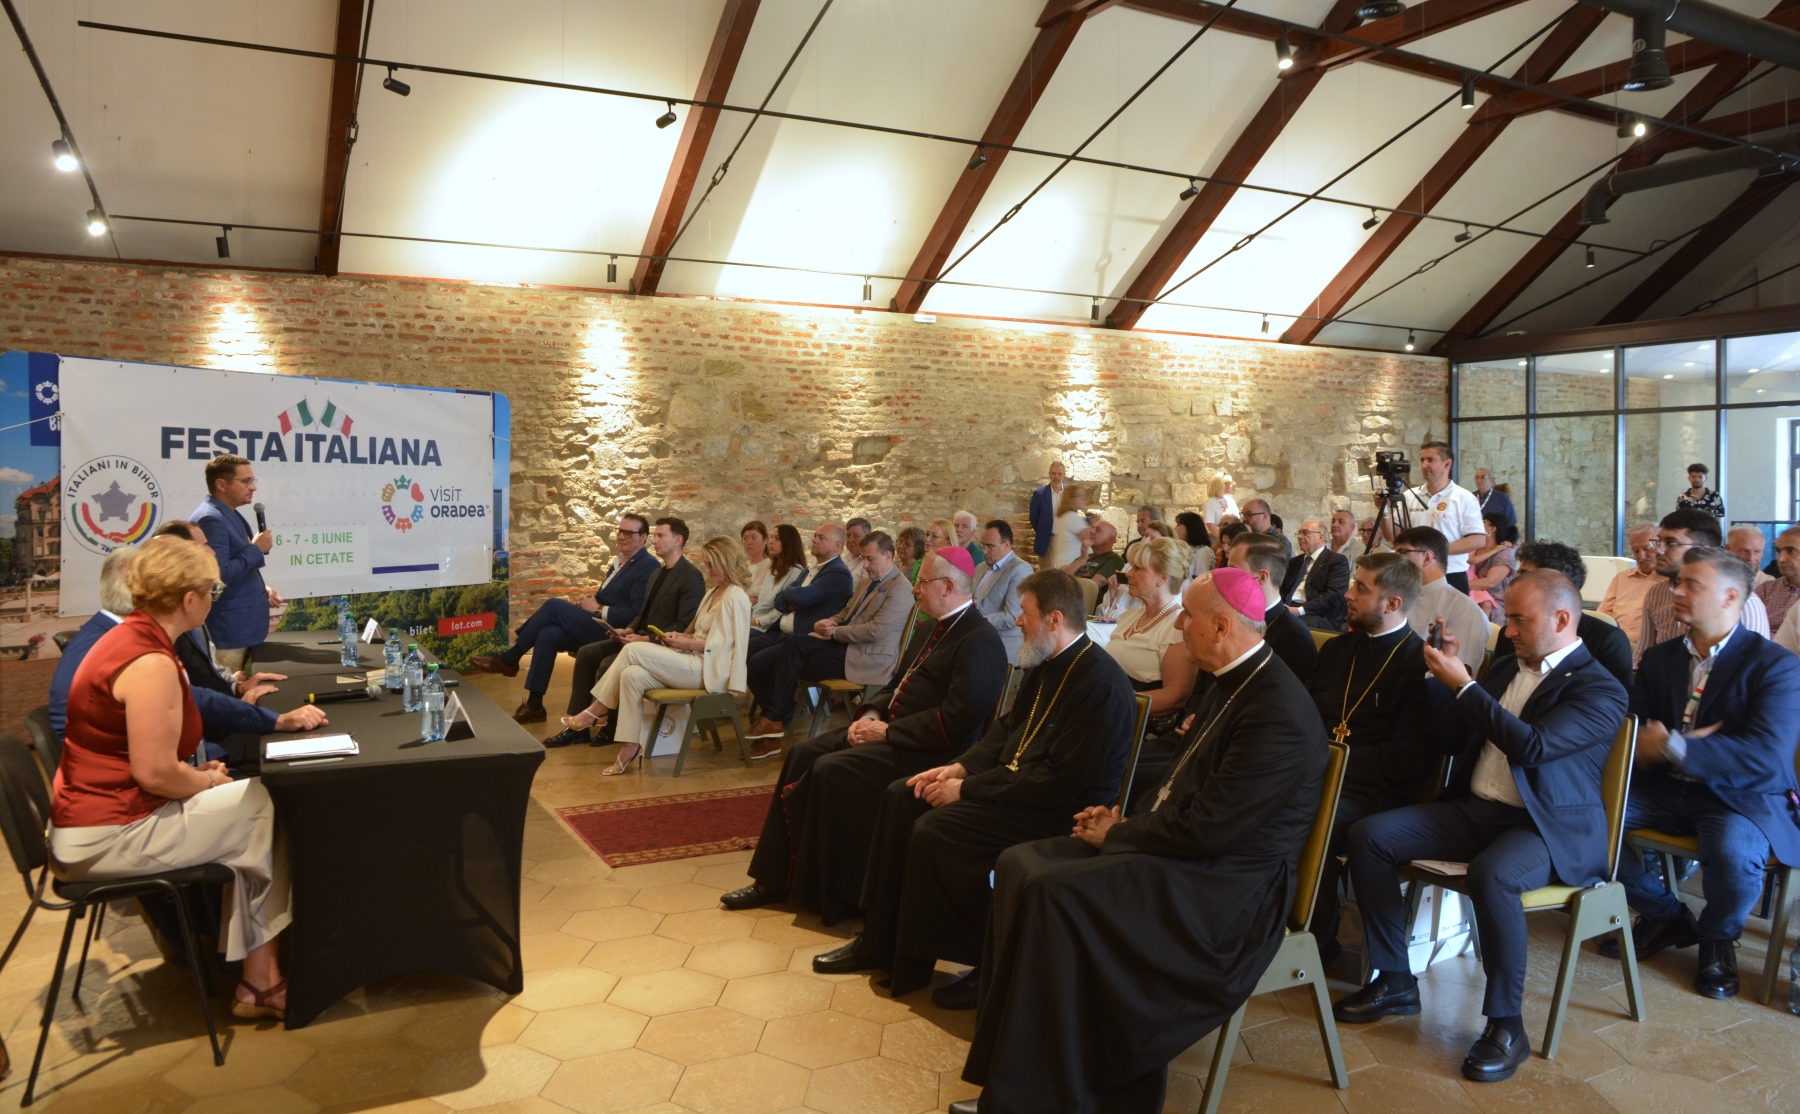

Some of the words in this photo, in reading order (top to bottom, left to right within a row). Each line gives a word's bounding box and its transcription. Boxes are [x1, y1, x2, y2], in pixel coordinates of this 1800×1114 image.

[161, 426, 288, 462] FESTA
[295, 432, 442, 466] ITALIANA
[67, 460, 111, 498] ITALIANI
[115, 460, 128, 470] IN
[132, 465, 159, 499] BIHOR
[275, 534, 283, 546] 6
[294, 534, 301, 545] 7
[311, 533, 319, 544] 8
[322, 532, 354, 544] IUNIE
[290, 554, 302, 566] IN
[306, 551, 354, 565] CETATE
[409, 625, 433, 636] bilet
[451, 619, 483, 631] lot.com
